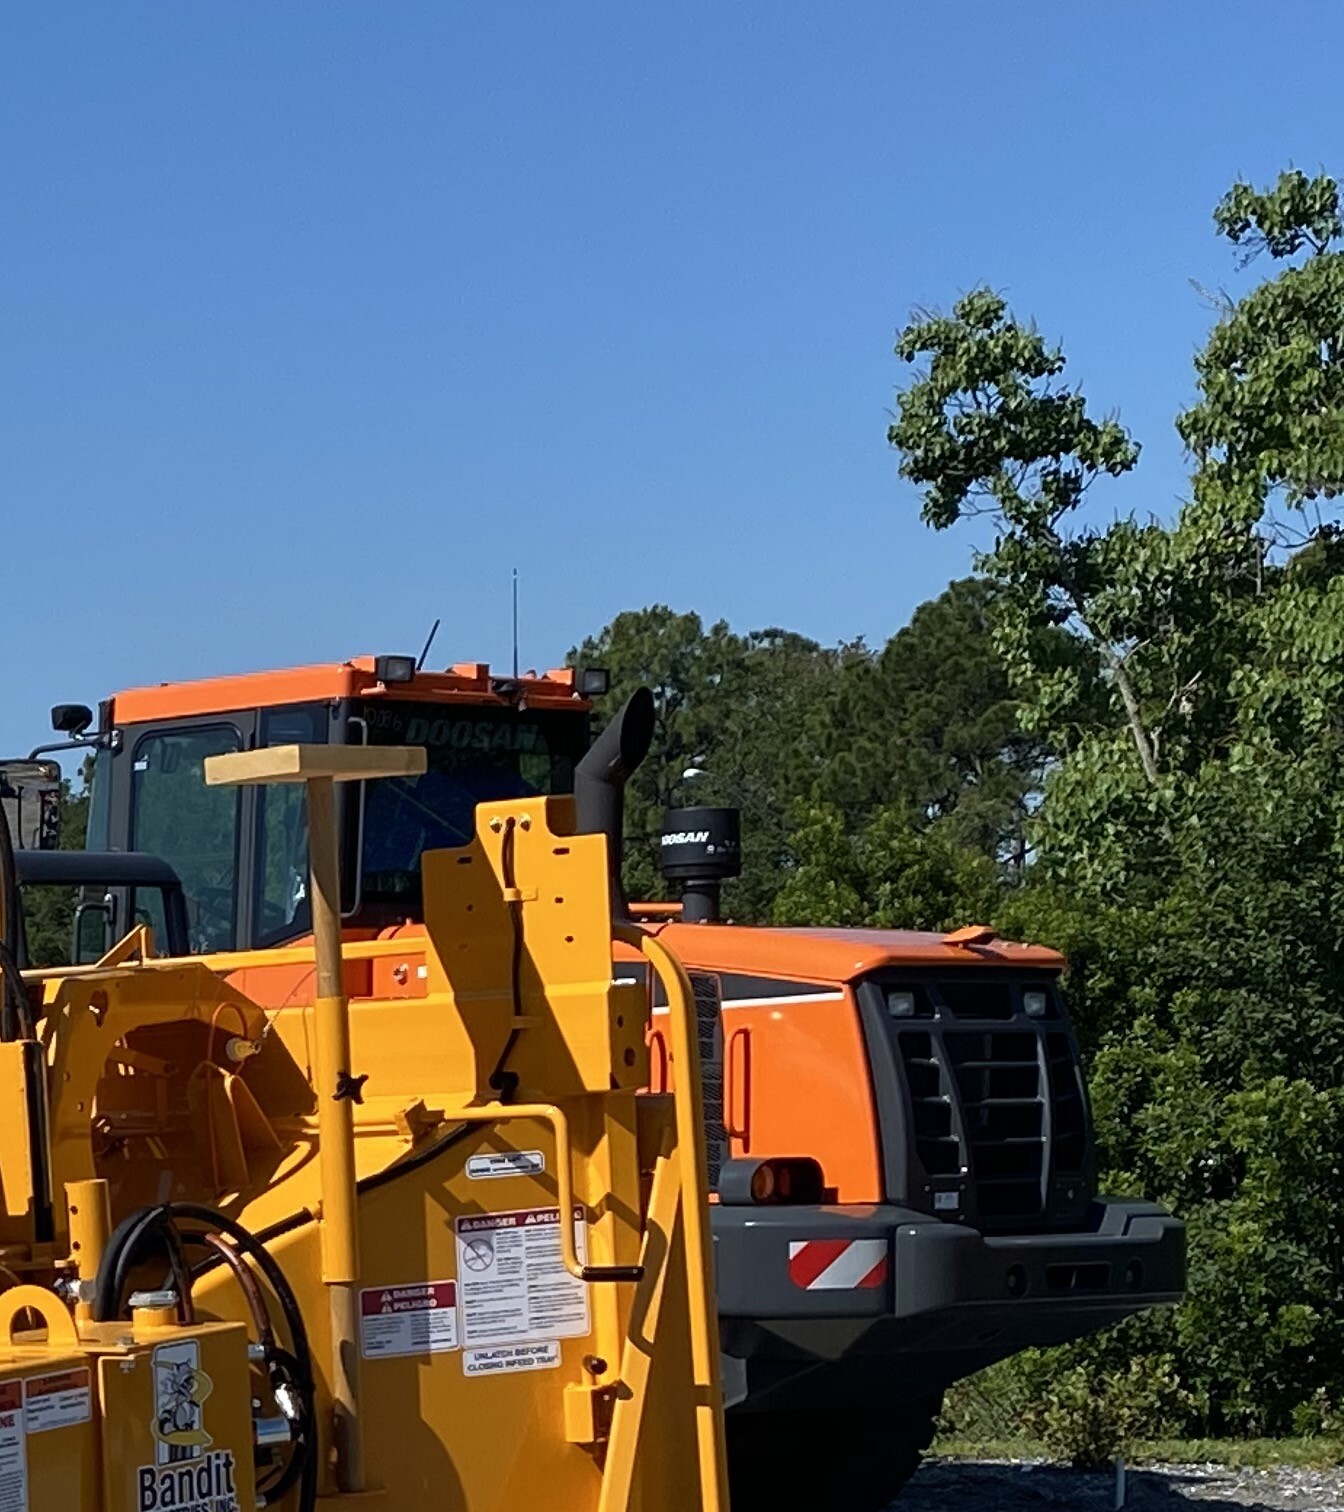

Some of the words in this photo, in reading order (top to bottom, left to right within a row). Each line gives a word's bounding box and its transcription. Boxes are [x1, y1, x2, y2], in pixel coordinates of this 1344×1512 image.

[406, 718, 539, 749] DOOSAN
[514, 1346, 549, 1356] BEFORE
[139, 1453, 234, 1512] Bandit
